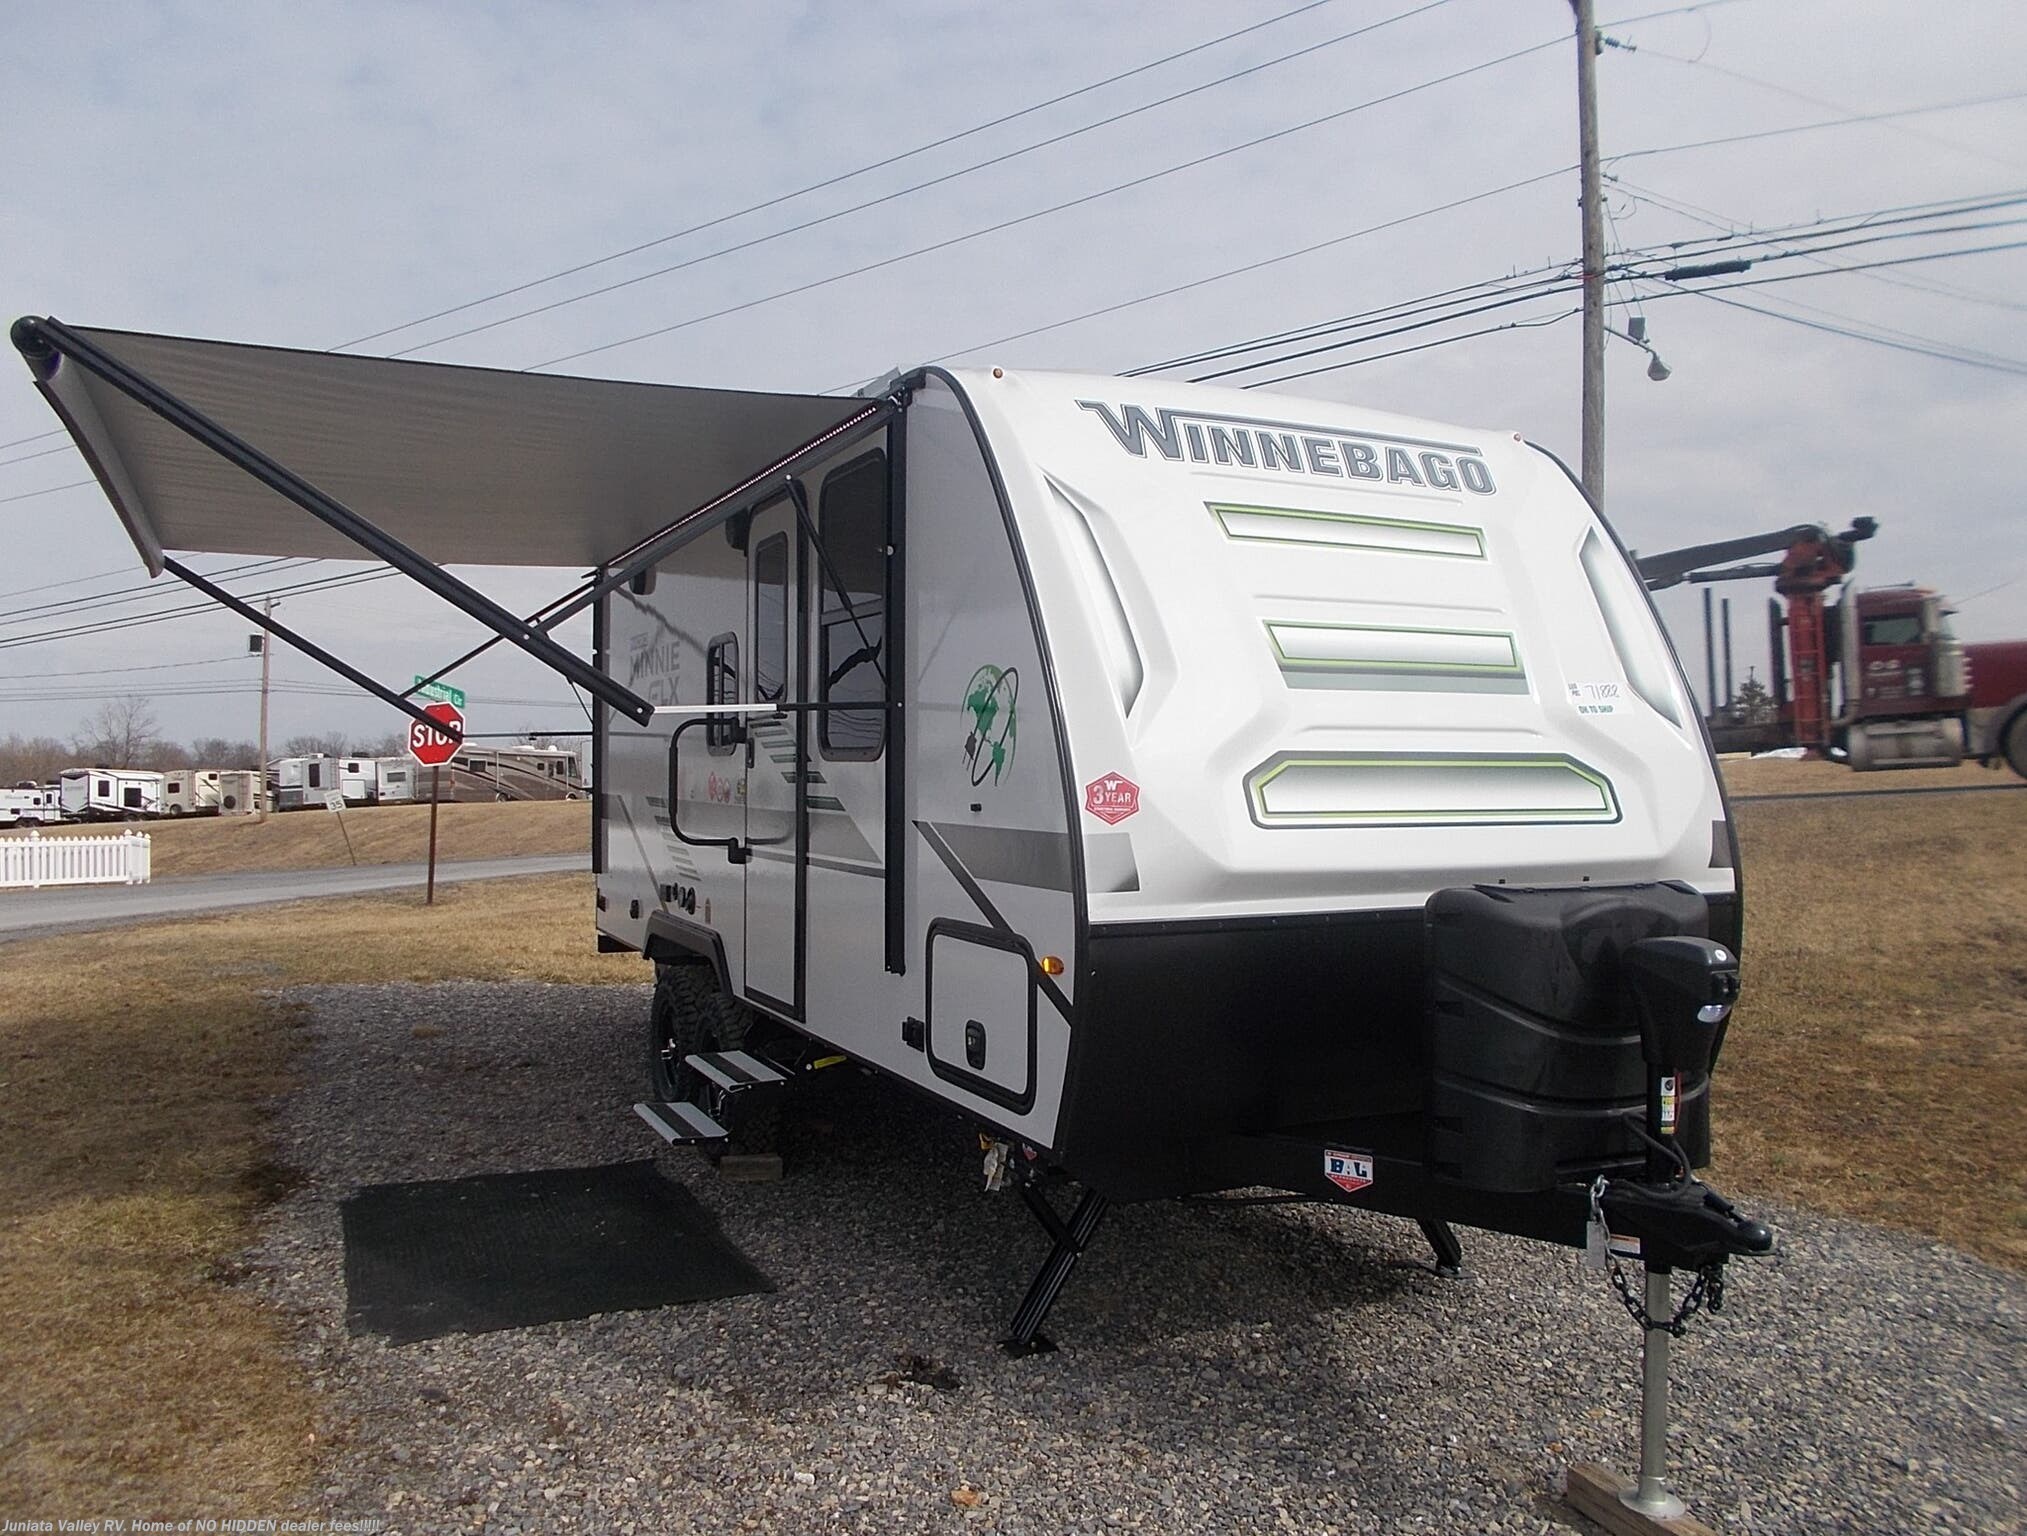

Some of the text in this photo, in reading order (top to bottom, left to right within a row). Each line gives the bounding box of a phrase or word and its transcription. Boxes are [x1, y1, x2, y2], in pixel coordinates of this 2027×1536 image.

[1074, 399, 1498, 497] WINNEBAGO
[1093, 785, 1131, 805] 3 YEAR
[329, 800, 343, 811] 35
[1330, 1157, 1368, 1178] BAL
